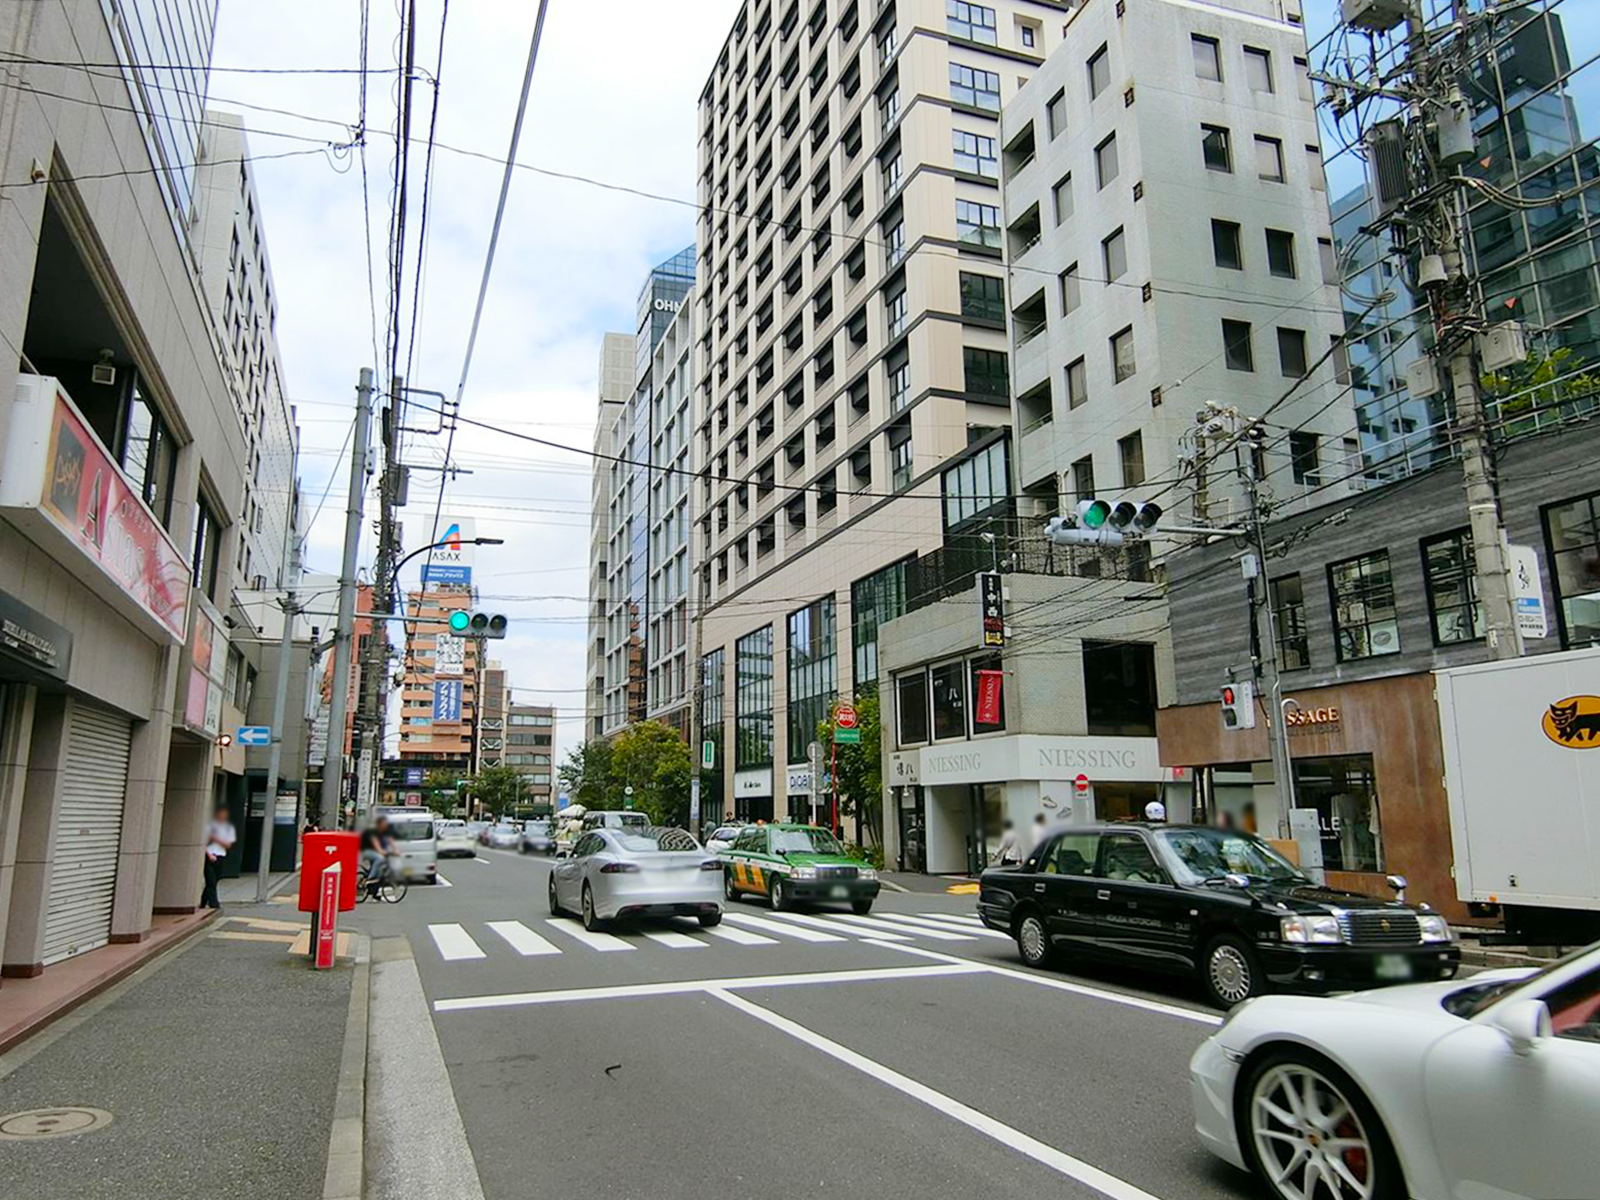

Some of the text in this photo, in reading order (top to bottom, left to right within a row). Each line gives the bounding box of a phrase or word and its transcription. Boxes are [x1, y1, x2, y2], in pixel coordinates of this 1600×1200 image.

[432, 552, 461, 561] ASAX
[984, 675, 994, 709] NIESSIN
[928, 753, 981, 773] NIESSING
[1038, 748, 1136, 768] NIESSING
